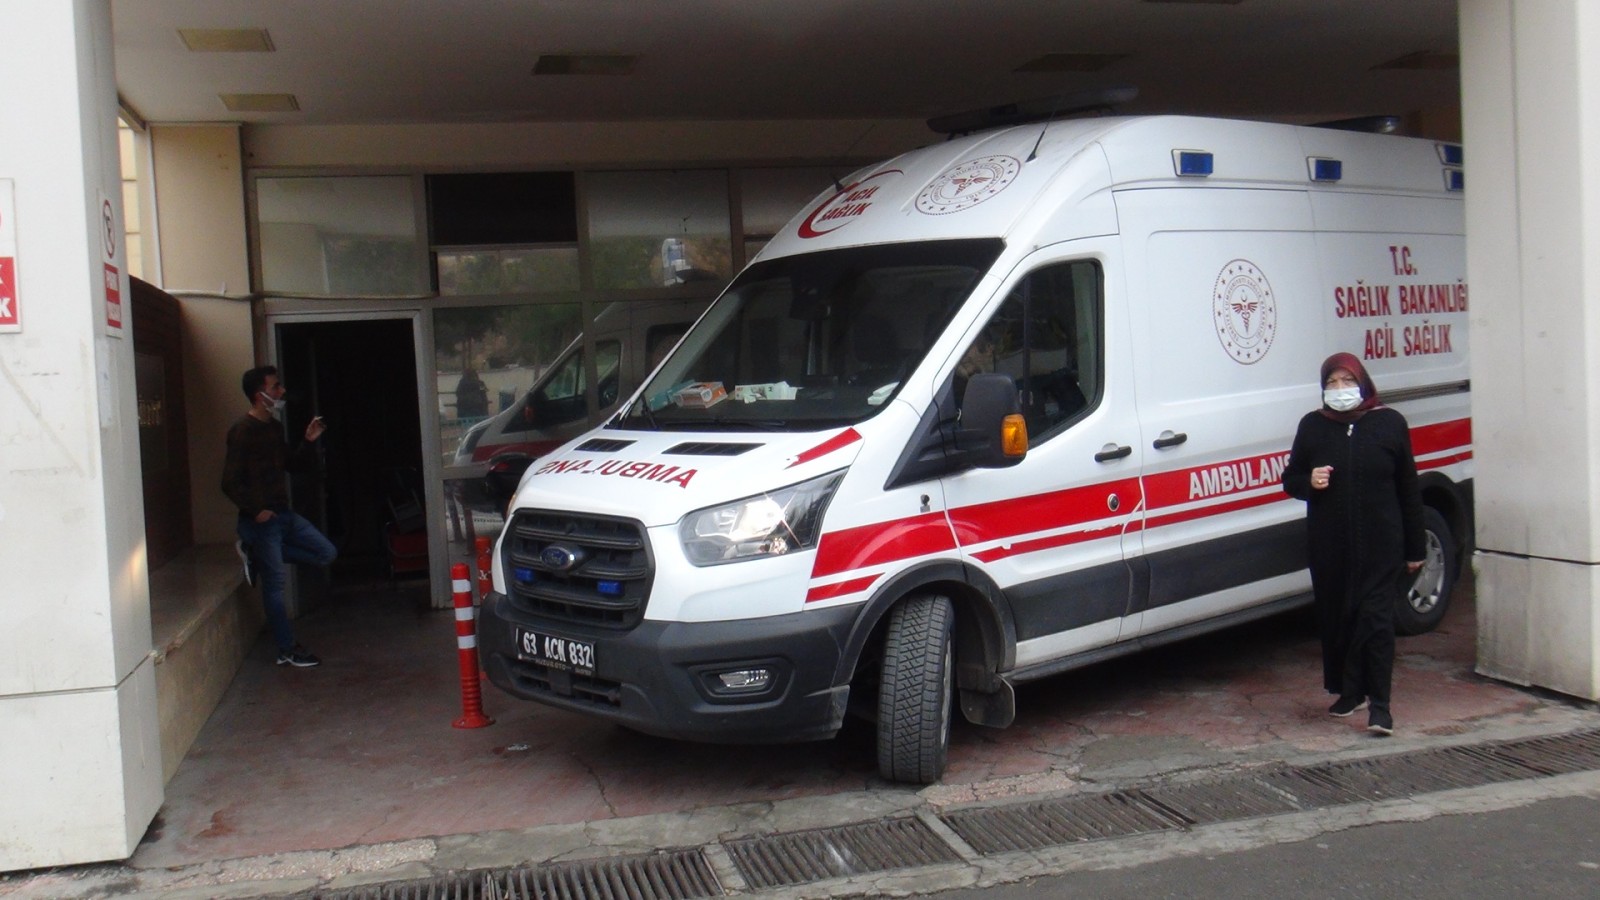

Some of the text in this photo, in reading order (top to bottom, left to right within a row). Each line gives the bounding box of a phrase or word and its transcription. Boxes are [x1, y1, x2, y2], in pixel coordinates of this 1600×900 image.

[1389, 246, 1418, 275] T.C.
[1334, 279, 1392, 318] SAĞLIK
[1364, 319, 1453, 360] ACİL SAĞLIK
[523, 632, 593, 668] 63 ACN 832
